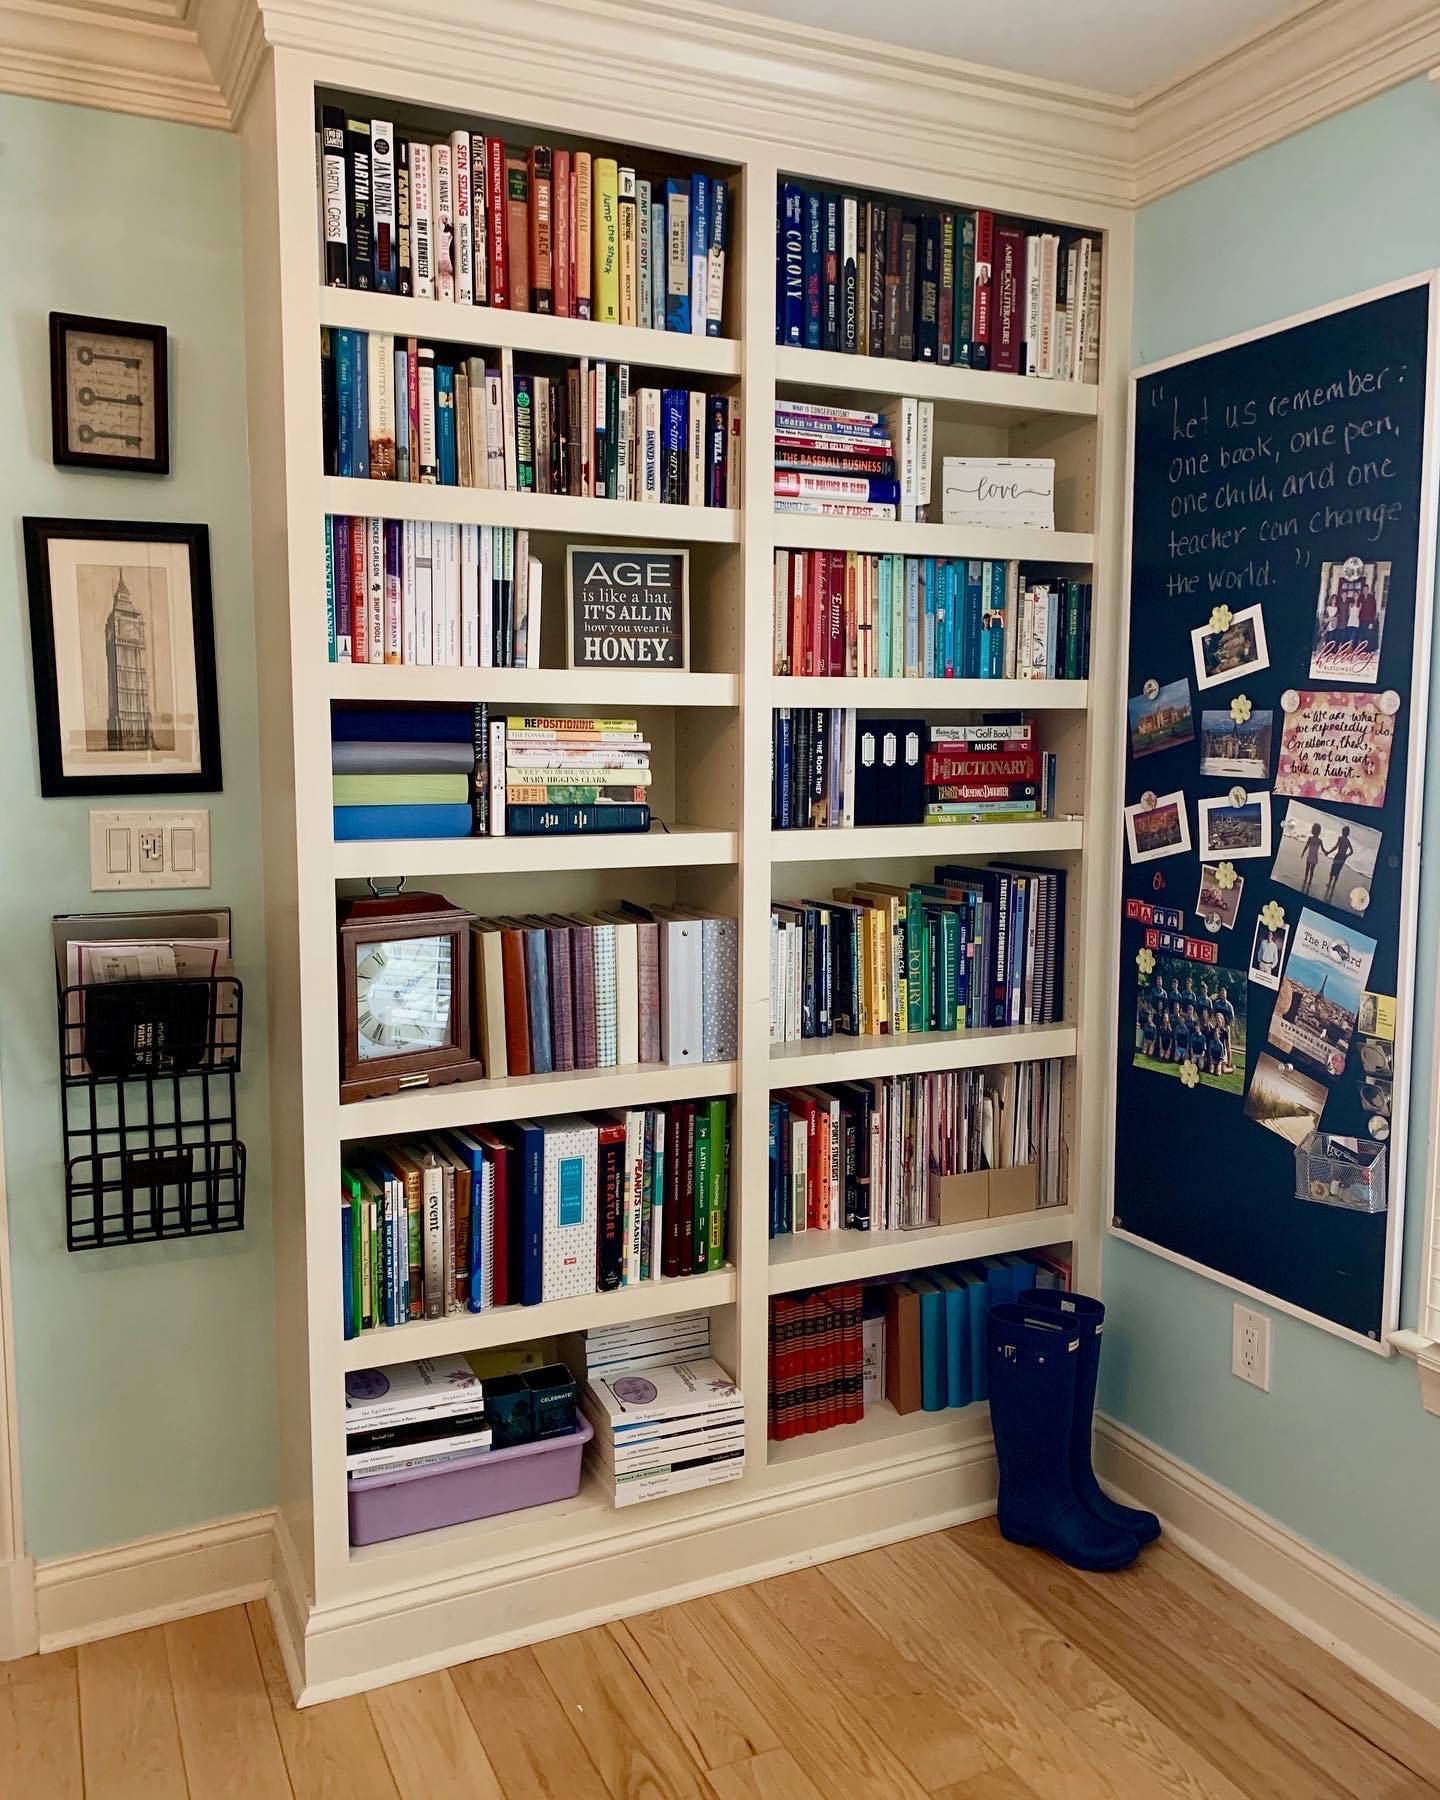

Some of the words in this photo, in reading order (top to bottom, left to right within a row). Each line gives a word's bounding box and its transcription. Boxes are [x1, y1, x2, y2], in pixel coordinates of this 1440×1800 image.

[458, 145, 467, 170] SPIN
[473, 139, 483, 165] MIKE
[327, 160, 340, 194] MARTIN
[354, 152, 369, 200] MARTHA
[374, 159, 391, 181] JAN
[374, 182, 392, 216] BURKE
[440, 180, 448, 204] WANNA
[458, 174, 468, 216] SELLING
[538, 186, 548, 208] MEN
[697, 182, 705, 213] nancy
[356, 202, 369, 218] inc.
[441, 204, 449, 212] BE
[539, 210, 548, 221] IN
[603, 193, 613, 222] jump
[328, 208, 341, 238] GROSS
[417, 219, 428, 235] TONY
[697, 216, 706, 250] thayer
[539, 224, 548, 256] BLACK
[604, 246, 615, 274] shark
[786, 230, 802, 300] COLONY
[944, 248, 952, 289] ROSENFELT
[1004, 244, 1012, 290] AMERICAN
[1002, 291, 1011, 344] LITERATURE
[378, 346, 386, 396] FORGOTTEN
[379, 399, 387, 433] GARDEN
[517, 406, 530, 427] DAN
[780, 417, 804, 426] Learn
[814, 420, 832, 430] Earn
[1225, 401, 1257, 429] us
[518, 427, 531, 461] BROWN
[618, 441, 626, 466] FICTION
[646, 430, 654, 460] DAMNED
[714, 431, 722, 463] WILL
[1169, 454, 1209, 484] one
[1221, 436, 1280, 469] book,
[1290, 424, 1336, 452] one
[783, 453, 798, 462] THE
[801, 455, 841, 467] BASEBALL
[843, 459, 881, 472] BUSINESS
[646, 461, 655, 491] YANKEES
[1171, 492, 1208, 519] one
[1215, 476, 1273, 509] child,
[1282, 462, 1335, 498] and
[1347, 457, 1398, 486] one
[822, 504, 832, 512] IF
[833, 505, 846, 514] AT
[1168, 526, 1248, 558] teacher
[1260, 518, 1298, 541] can
[1309, 502, 1402, 542] change
[340, 547, 350, 582] Successful
[583, 562, 671, 586] AGE
[340, 584, 350, 603] Event
[355, 571, 363, 593] PRESS
[1166, 571, 1200, 597] the
[582, 588, 594, 602] is
[599, 588, 627, 602] like
[631, 593, 639, 603] a
[644, 589, 672, 604] hat.
[340, 604, 349, 634] Planning
[356, 606, 364, 624] MARK
[583, 605, 616, 620] IT'S
[619, 605, 651, 620] ALL
[655, 606, 672, 621] IN
[831, 593, 842, 639] Emma
[584, 622, 607, 632] how
[609, 625, 631, 635] you
[632, 625, 659, 633] wear
[356, 636, 364, 656] LEVIN
[584, 637, 673, 662] HONEY.
[1315, 640, 1375, 673] holiday
[524, 719, 595, 729] REPOSITIONING
[1295, 725, 1308, 733] we
[1329, 712, 1345, 720] are
[1350, 712, 1381, 723] what
[975, 728, 993, 738] Golf
[994, 730, 1009, 738] Book
[975, 743, 997, 751] MUSIC
[1298, 750, 1308, 761] is
[1313, 750, 1334, 760] not
[1335, 755, 1349, 763] an
[951, 759, 1027, 775] DICTIONARY
[1290, 761, 1310, 776] but
[1313, 767, 1320, 775] a
[999, 878, 1008, 911] STRATEGIC
[998, 912, 1006, 931] SPORT
[1128, 902, 1178, 927] MATT
[1148, 932, 1212, 961] ELLIE
[1304, 931, 1319, 946] The
[997, 932, 1005, 982] COMMUNICATION
[909, 950, 920, 1007] POETRY
[1280, 1021, 1313, 1042] STEPHANIE
[606, 1151, 615, 1239] LITERATURE
[634, 1158, 642, 1206] PEANUTS
[428, 1195, 440, 1231] event
